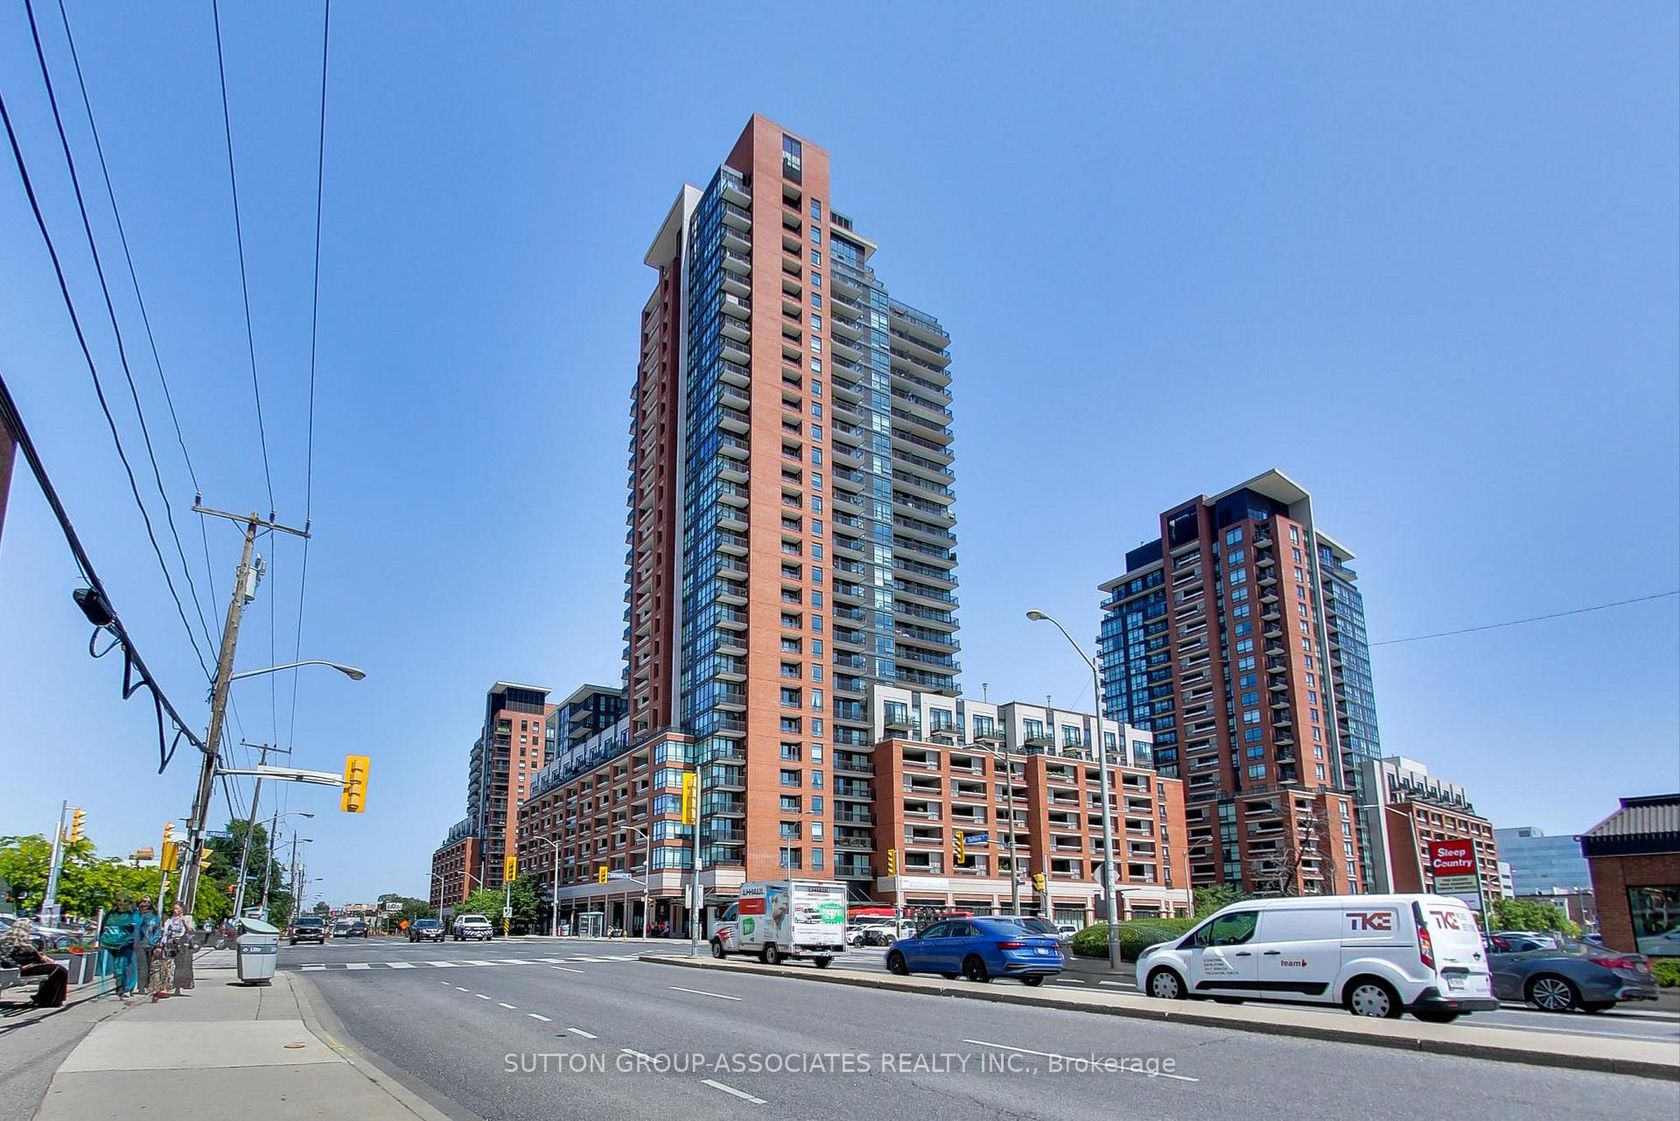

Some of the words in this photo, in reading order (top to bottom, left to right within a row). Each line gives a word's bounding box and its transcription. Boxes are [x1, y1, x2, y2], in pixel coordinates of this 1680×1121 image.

[1437, 847, 1466, 858] Sleep
[1433, 858, 1473, 868] Country
[1345, 912, 1392, 931] TKE
[1429, 910, 1460, 930] TKE
[1280, 959, 1301, 967] team
